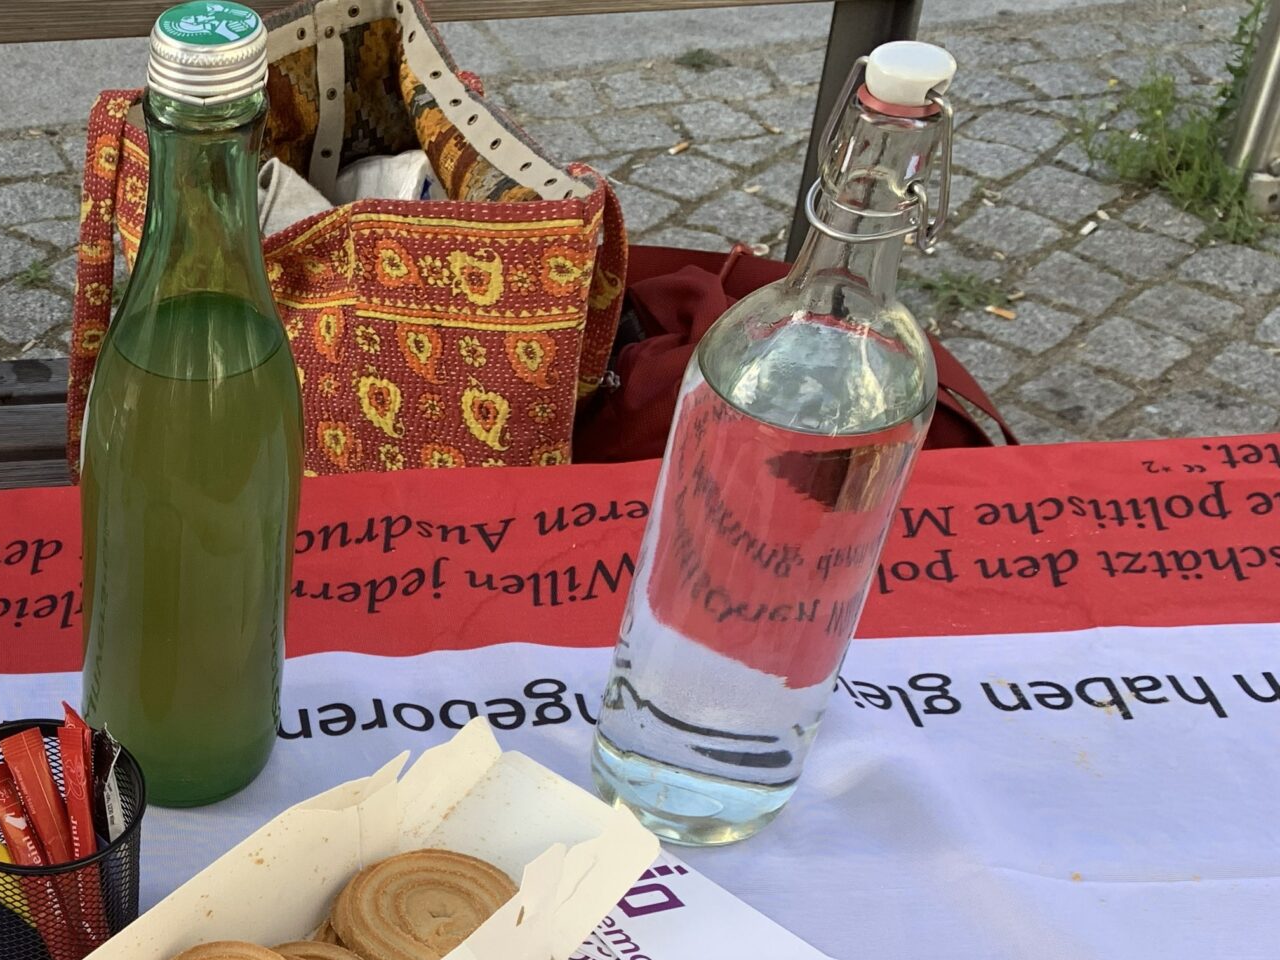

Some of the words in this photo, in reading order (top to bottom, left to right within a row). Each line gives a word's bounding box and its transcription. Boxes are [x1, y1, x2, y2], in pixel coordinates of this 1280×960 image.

[535, 500, 650, 536] eren
[975, 480, 1232, 536] politische
[295, 516, 515, 554] Ausdruc
[975, 549, 1079, 588] den
[980, 673, 1228, 720] haben
